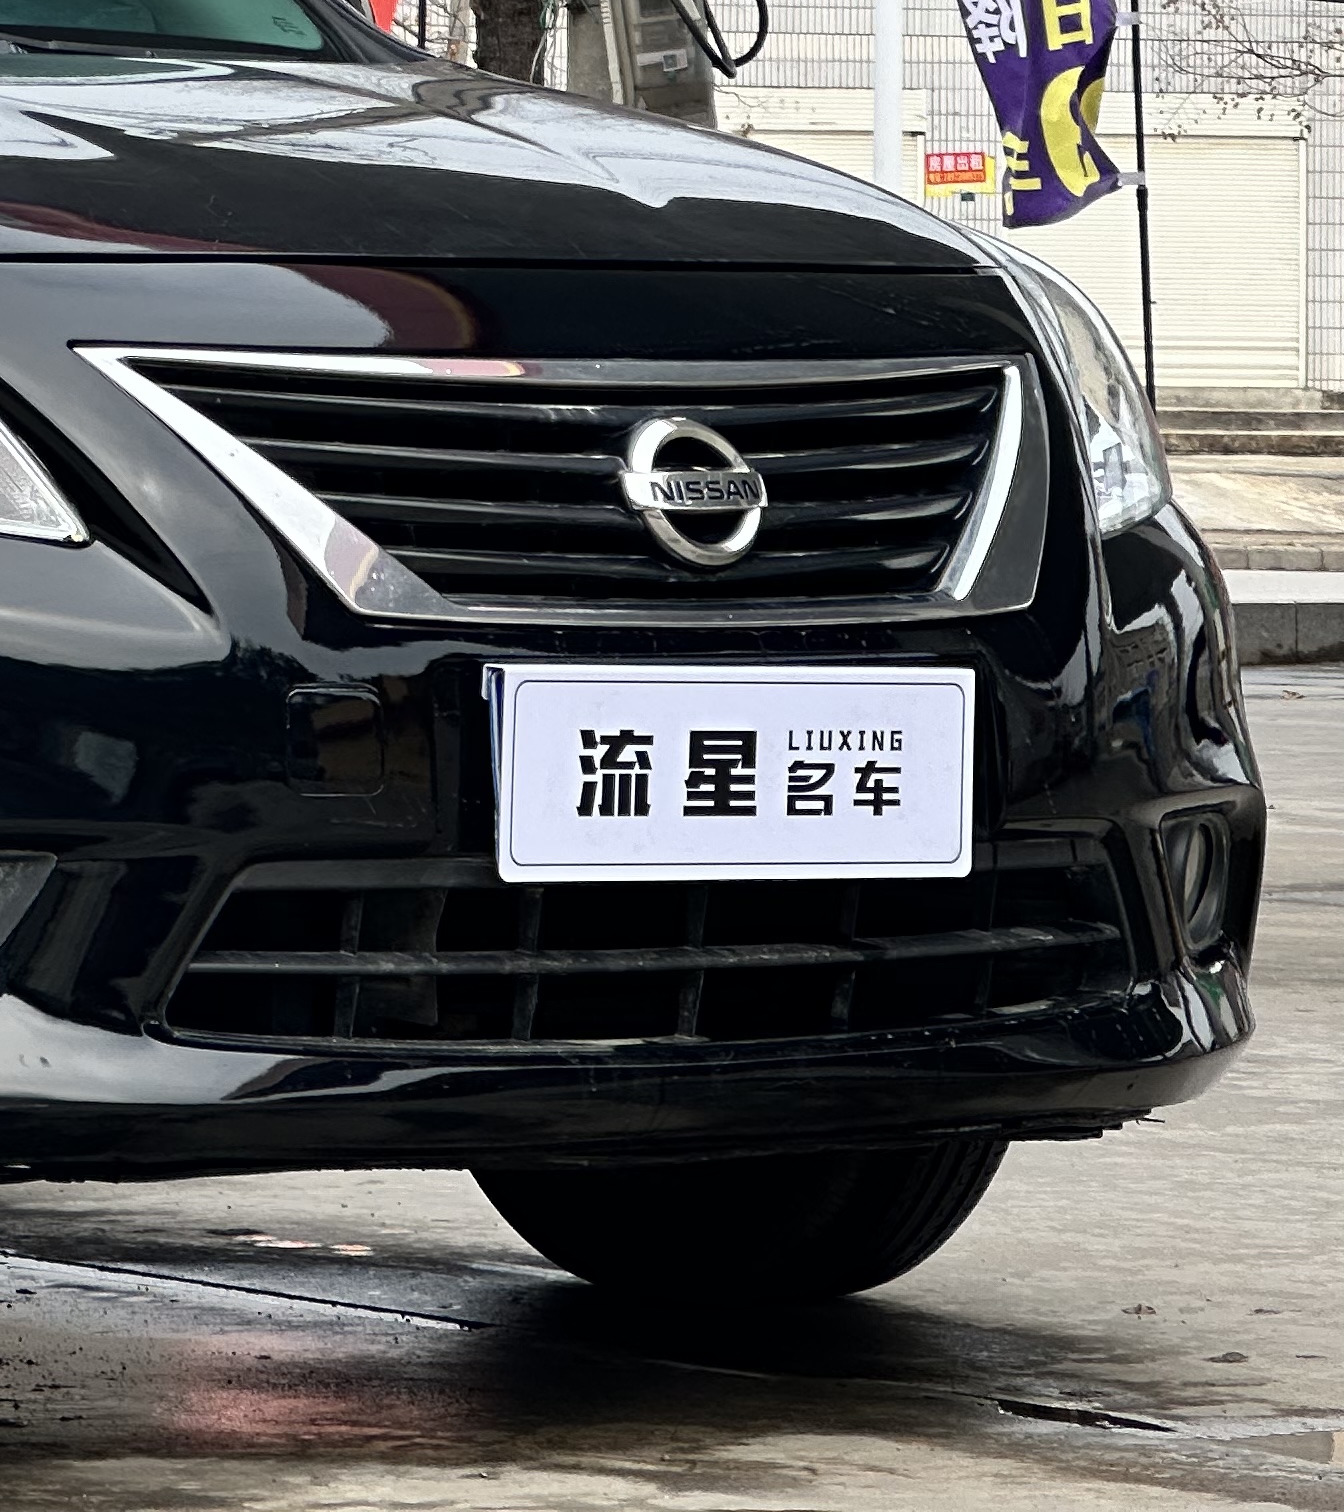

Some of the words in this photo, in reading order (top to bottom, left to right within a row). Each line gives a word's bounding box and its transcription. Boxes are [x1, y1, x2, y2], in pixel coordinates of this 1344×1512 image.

[649, 478, 761, 503] NISSAN
[787, 729, 904, 752] LIUXING
[576, 728, 758, 817] 流星
[786, 759, 903, 817] 名车
